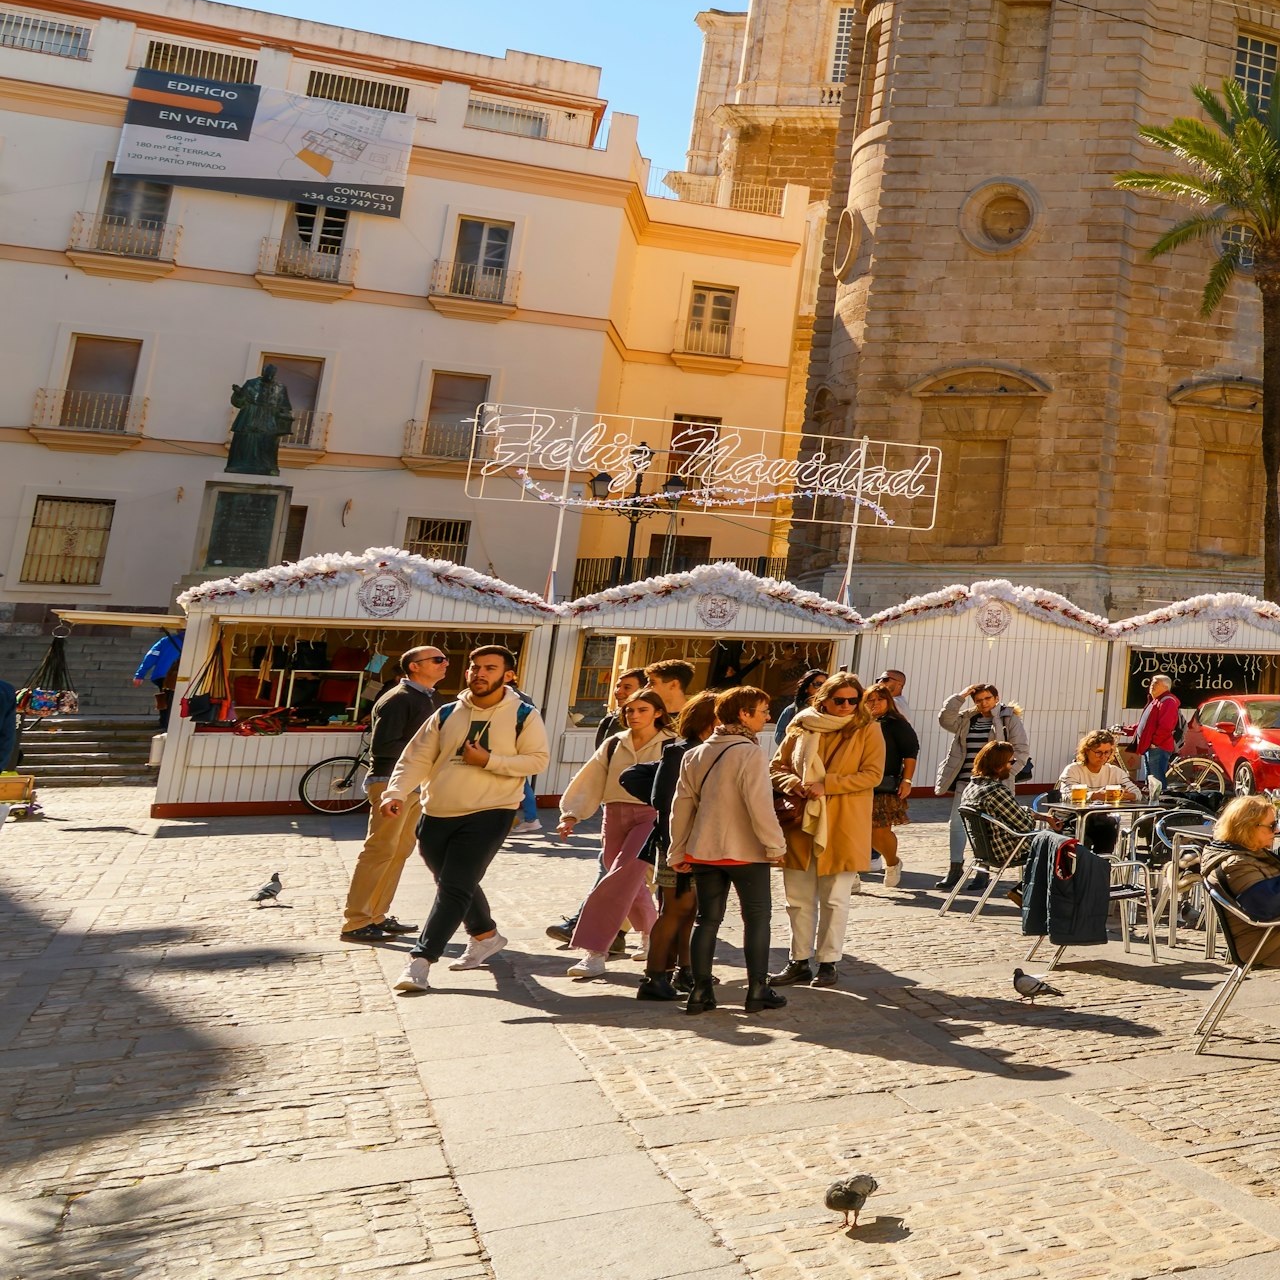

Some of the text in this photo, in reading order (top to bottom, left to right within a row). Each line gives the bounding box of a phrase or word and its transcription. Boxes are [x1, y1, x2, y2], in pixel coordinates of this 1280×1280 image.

[167, 80, 238, 100] EDIFICIO
[159, 110, 238, 131] EN VENTA
[168, 145, 181, 153] DE
[182, 147, 222, 158] TERRAZA
[127, 152, 143, 160] 120
[158, 157, 185, 165] PATIO
[186, 160, 227, 171] PRIVADO
[302, 192, 392, 211] +34 622 747 731
[333, 186, 395, 203] CONTACTO
[481, 413, 932, 499] Feliz Navidad
[1143, 657, 1199, 674] Deseo
